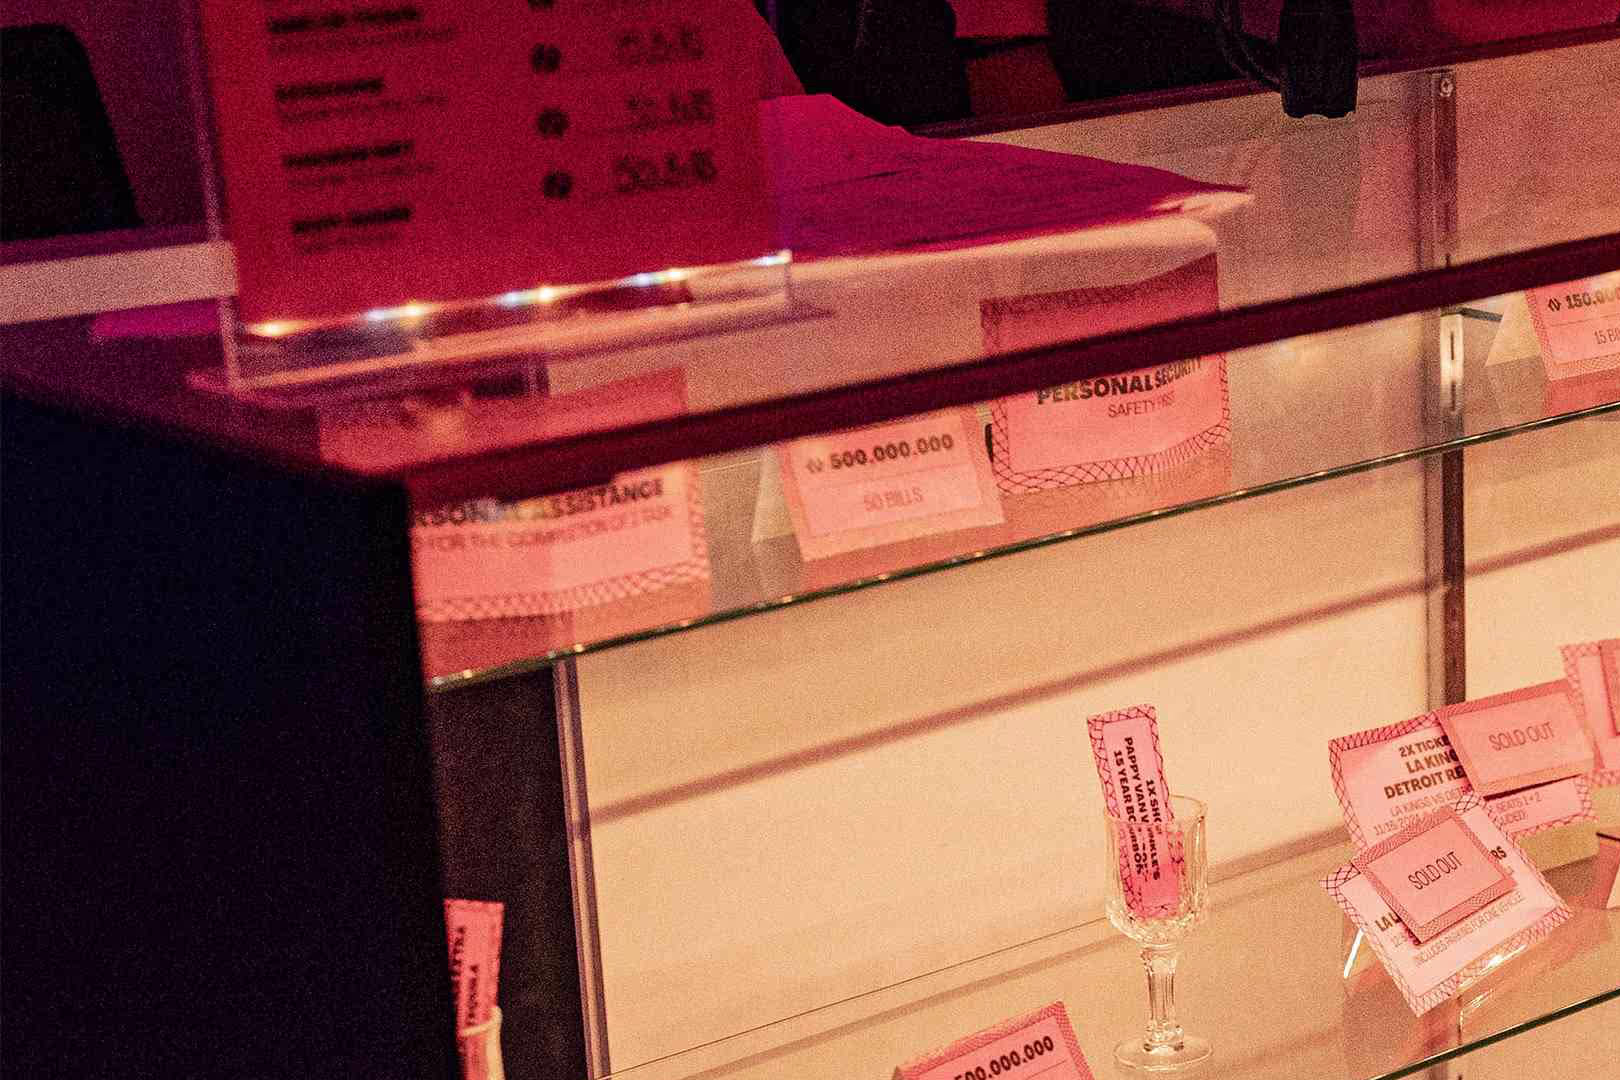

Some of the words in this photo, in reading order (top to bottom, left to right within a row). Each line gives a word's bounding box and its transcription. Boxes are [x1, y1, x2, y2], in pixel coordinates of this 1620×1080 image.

[1037, 373, 1154, 405] PERSONAL
[1107, 399, 1155, 418] SAFETY
[830, 434, 954, 471] 500.000.000
[1400, 743, 1417, 758] 2X
[1488, 727, 1528, 752] SOLD
[1526, 721, 1555, 743] OUT
[1124, 736, 1141, 782] PAPPY
[1134, 784, 1147, 813] VAN
[1406, 757, 1424, 774] LA
[1117, 768, 1132, 804] YEAR
[1384, 772, 1445, 800] DETROIT
[1408, 863, 1441, 890] SOLD
[1435, 851, 1463, 875] OUT
